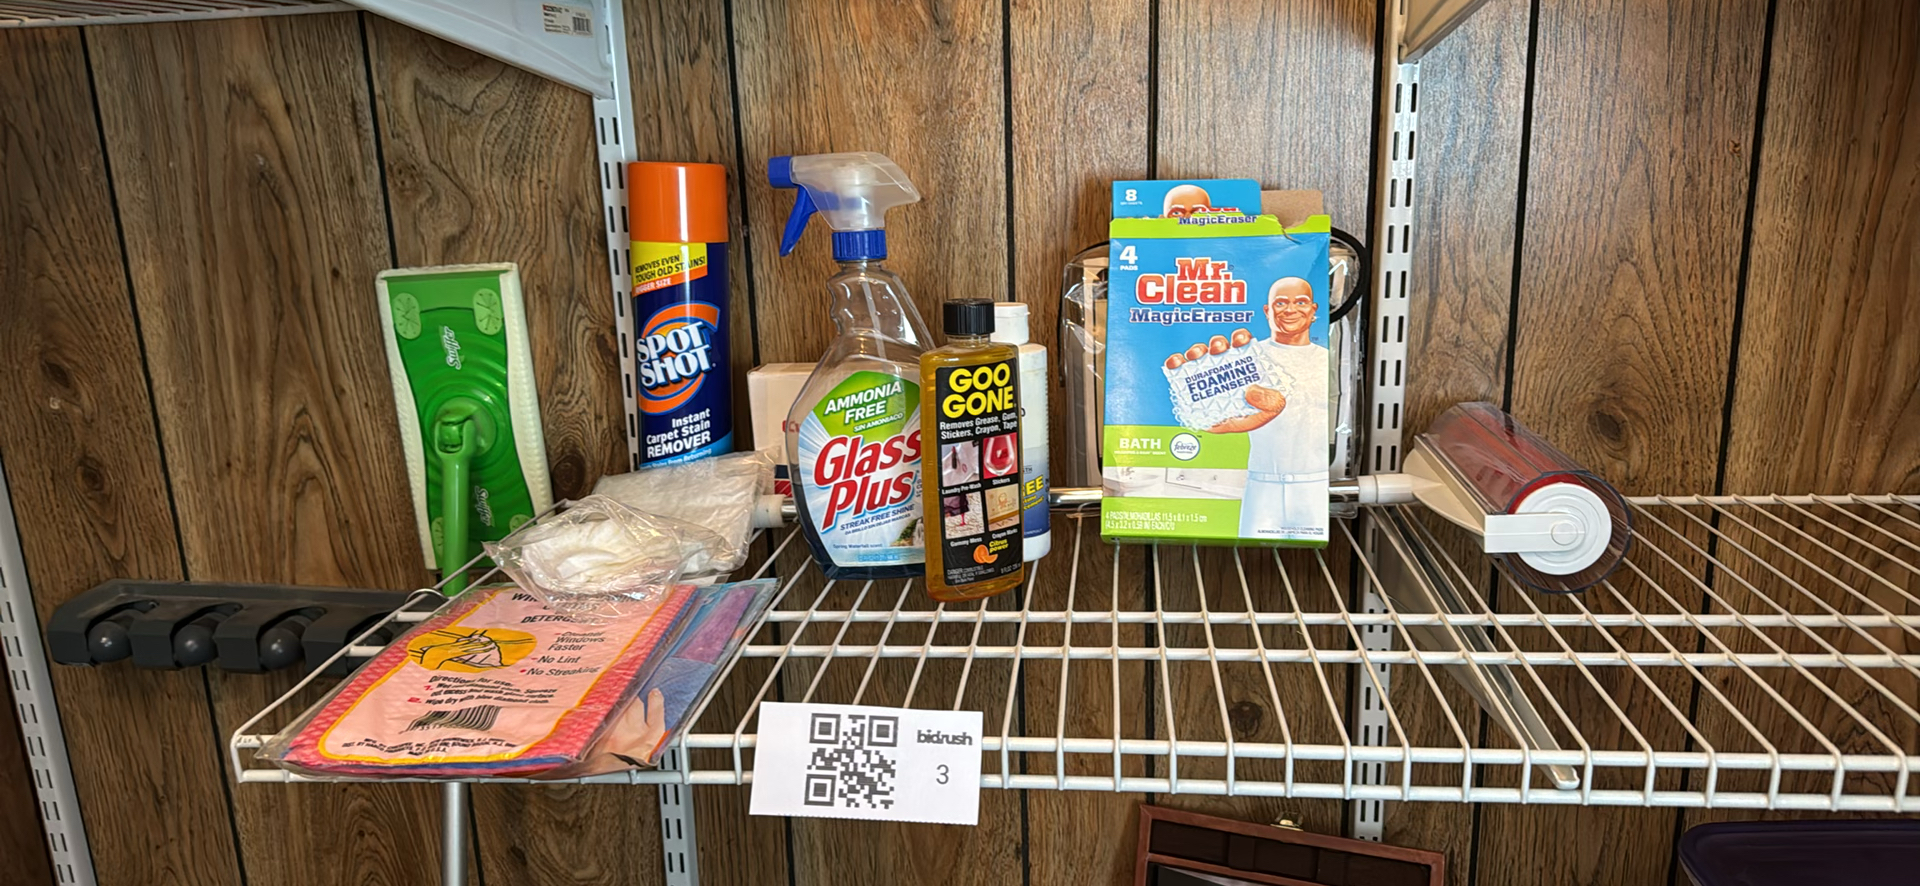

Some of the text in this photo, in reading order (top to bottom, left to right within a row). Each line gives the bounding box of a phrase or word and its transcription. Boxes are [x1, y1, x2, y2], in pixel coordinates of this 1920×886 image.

[1125, 189, 1137, 201] 8
[1178, 215, 1257, 226] MagicEraser
[661, 255, 680, 266] EVEN
[1120, 246, 1138, 264] 4
[657, 265, 673, 277] OLD
[675, 256, 706, 272] STINS!
[1176, 258, 1230, 280] Mr.
[656, 277, 671, 288] SIZE
[1137, 275, 1247, 304] Clean
[1131, 309, 1254, 324] MagicEraser
[442, 326, 461, 370] Swiffer
[636, 321, 704, 363] SPOT
[640, 344, 711, 387] SHOT
[1185, 356, 1253, 384] DURAFOAM AND
[949, 362, 1010, 393] GOO
[1188, 363, 1257, 394] FOAMING
[1191, 373, 1261, 402] CLEANSERS
[824, 381, 903, 415] AMMONIA
[942, 386, 1014, 419] GONE
[672, 408, 710, 428] Instant
[844, 401, 886, 424] FREE
[940, 420, 974, 431] Removes
[975, 415, 1001, 426] Grease,
[1002, 412, 1018, 421] Gum,
[646, 420, 711, 444] Carpet Stain
[941, 421, 1017, 439] Stickers, Crayon, Tape
[646, 431, 711, 458] REMOVER
[1119, 438, 1161, 449] BATH
[814, 430, 921, 486] Glass
[474, 486, 490, 526] Swiffer
[822, 472, 914, 531] Plus
[840, 517, 871, 531] STREAK
[870, 512, 891, 523] FREE
[556, 656, 581, 664] Lint
[526, 667, 544, 676] No
[917, 729, 973, 746] bidrush
[936, 764, 950, 785] 3
